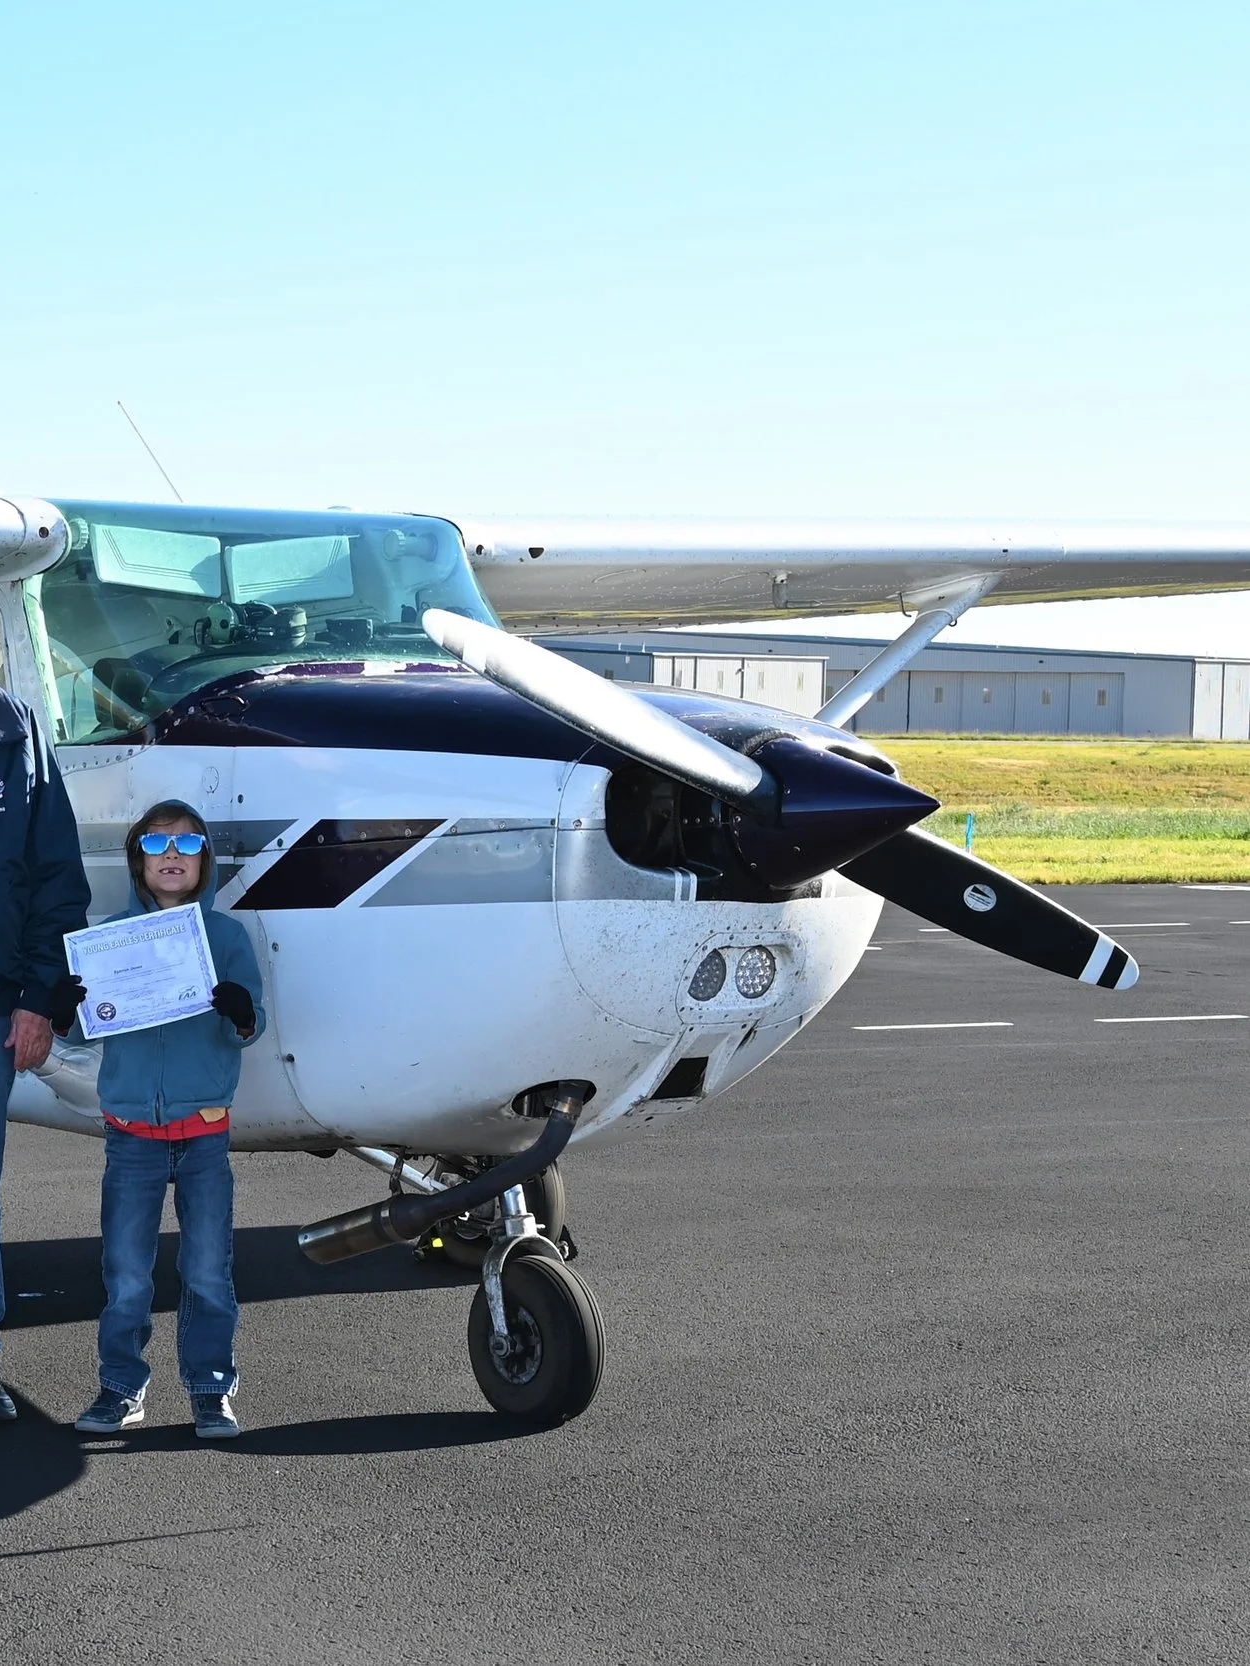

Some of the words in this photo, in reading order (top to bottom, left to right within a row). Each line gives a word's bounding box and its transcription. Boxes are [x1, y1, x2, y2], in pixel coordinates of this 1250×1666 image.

[83, 943, 110, 955] YOUNG
[110, 936, 139, 949] EAGLES
[139, 925, 185, 942] CERTIFICATE
